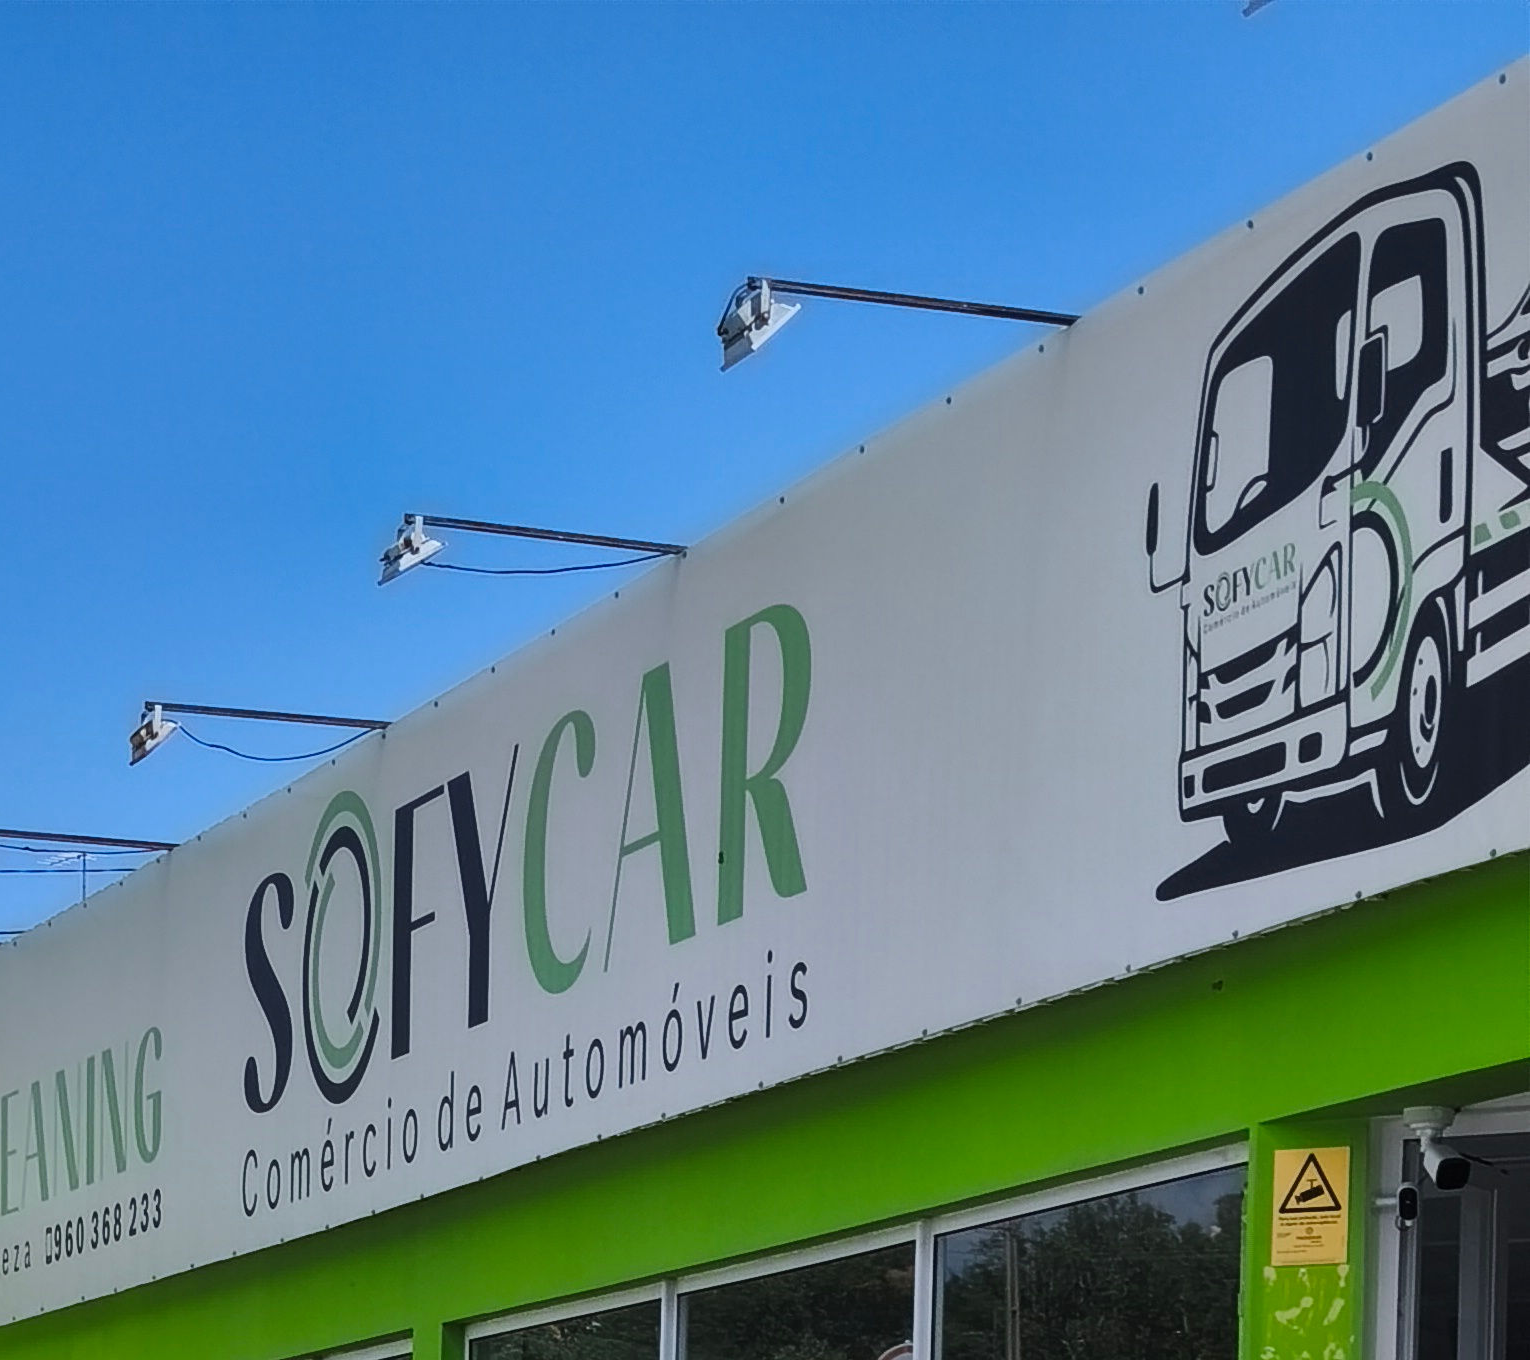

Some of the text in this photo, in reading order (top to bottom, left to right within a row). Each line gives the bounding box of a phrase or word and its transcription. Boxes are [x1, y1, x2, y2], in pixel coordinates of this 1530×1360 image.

[1203, 543, 1296, 617] SOFYCAR
[242, 603, 812, 1115] SOFYCAR
[241, 949, 809, 1217] Comércio de Automóveis
[90, 1203, 121, 1250] 368
[128, 1188, 162, 1237] 233
